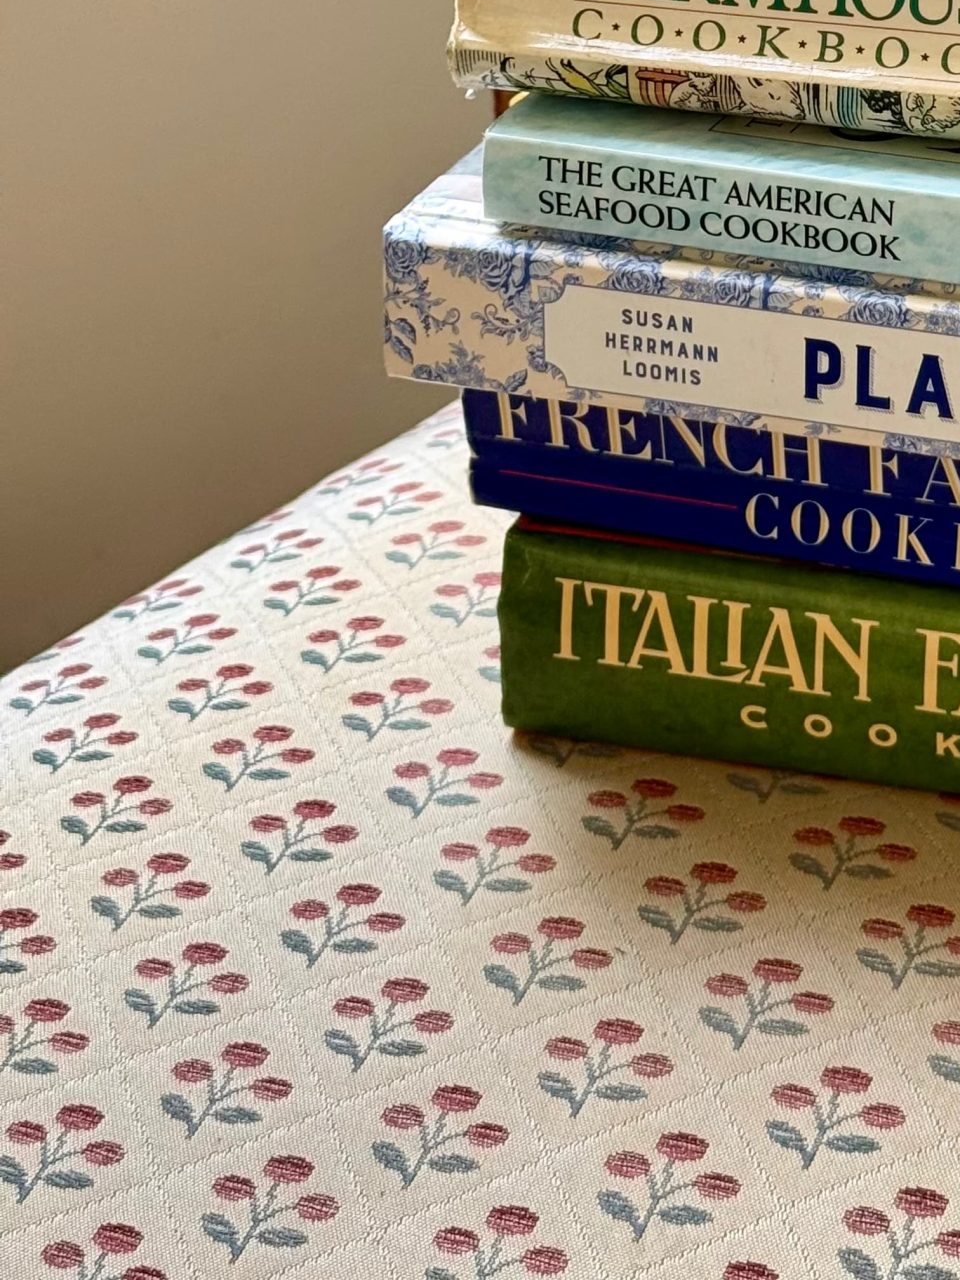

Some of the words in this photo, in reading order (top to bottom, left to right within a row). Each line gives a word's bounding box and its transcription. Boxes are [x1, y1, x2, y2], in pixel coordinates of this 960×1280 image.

[538, 155, 604, 188] THE
[611, 165, 717, 203] GREAT
[723, 179, 895, 227] AMERICAN
[538, 189, 691, 233] SEAFOOD
[699, 210, 902, 262] COOKBOOK
[605, 332, 718, 362] HERRMANN
[621, 308, 693, 333] SUSAN
[623, 359, 701, 385] LOOMIS
[495, 391, 829, 486] FRENCH
[553, 577, 880, 702] ITALIAN
